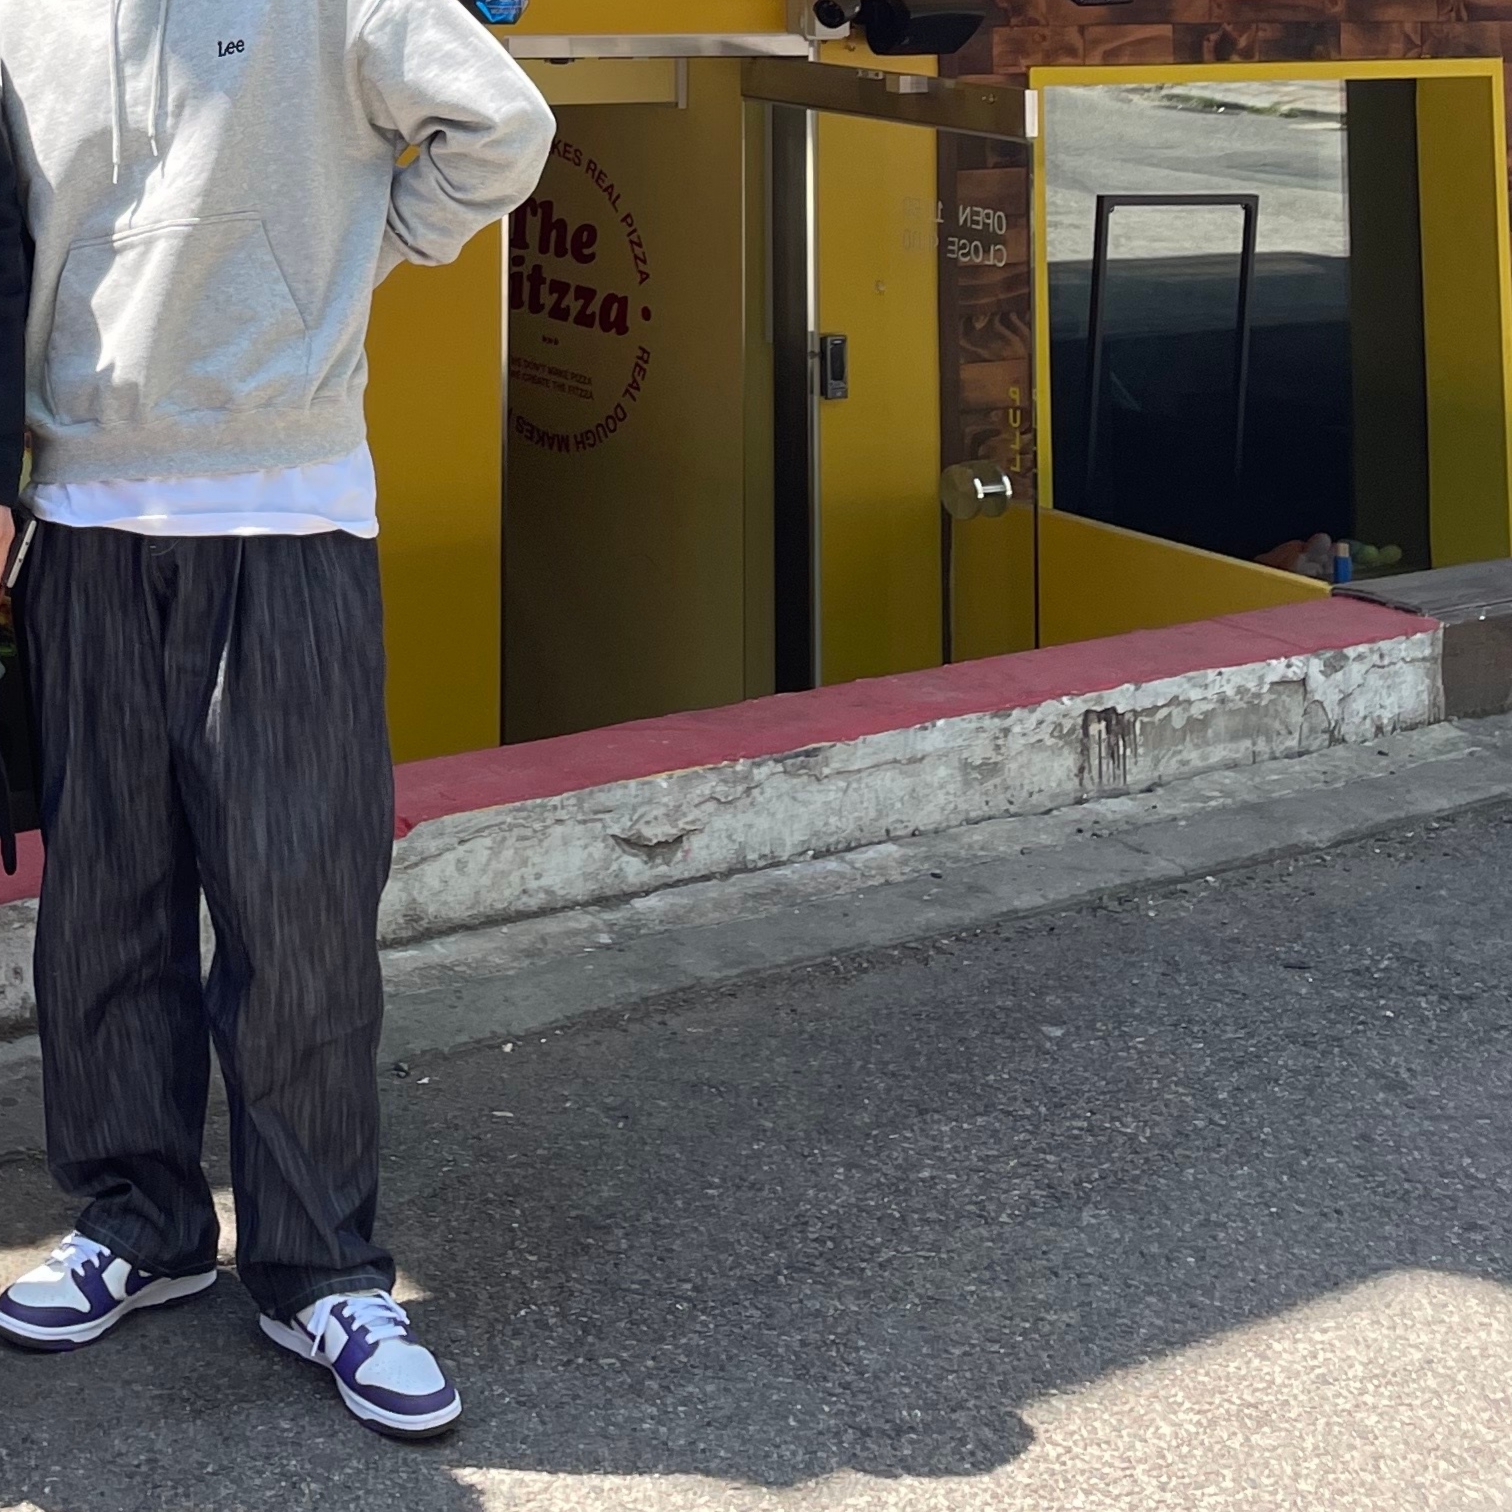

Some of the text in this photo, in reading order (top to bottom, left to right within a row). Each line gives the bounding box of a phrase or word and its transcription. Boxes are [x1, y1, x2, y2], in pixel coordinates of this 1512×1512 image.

[218, 39, 245, 57] Lee
[586, 158, 621, 213] REAL
[620, 212, 650, 286] PIZZA
[509, 254, 630, 336] itzza
[516, 345, 651, 453] REAL DOUGH MAKES
